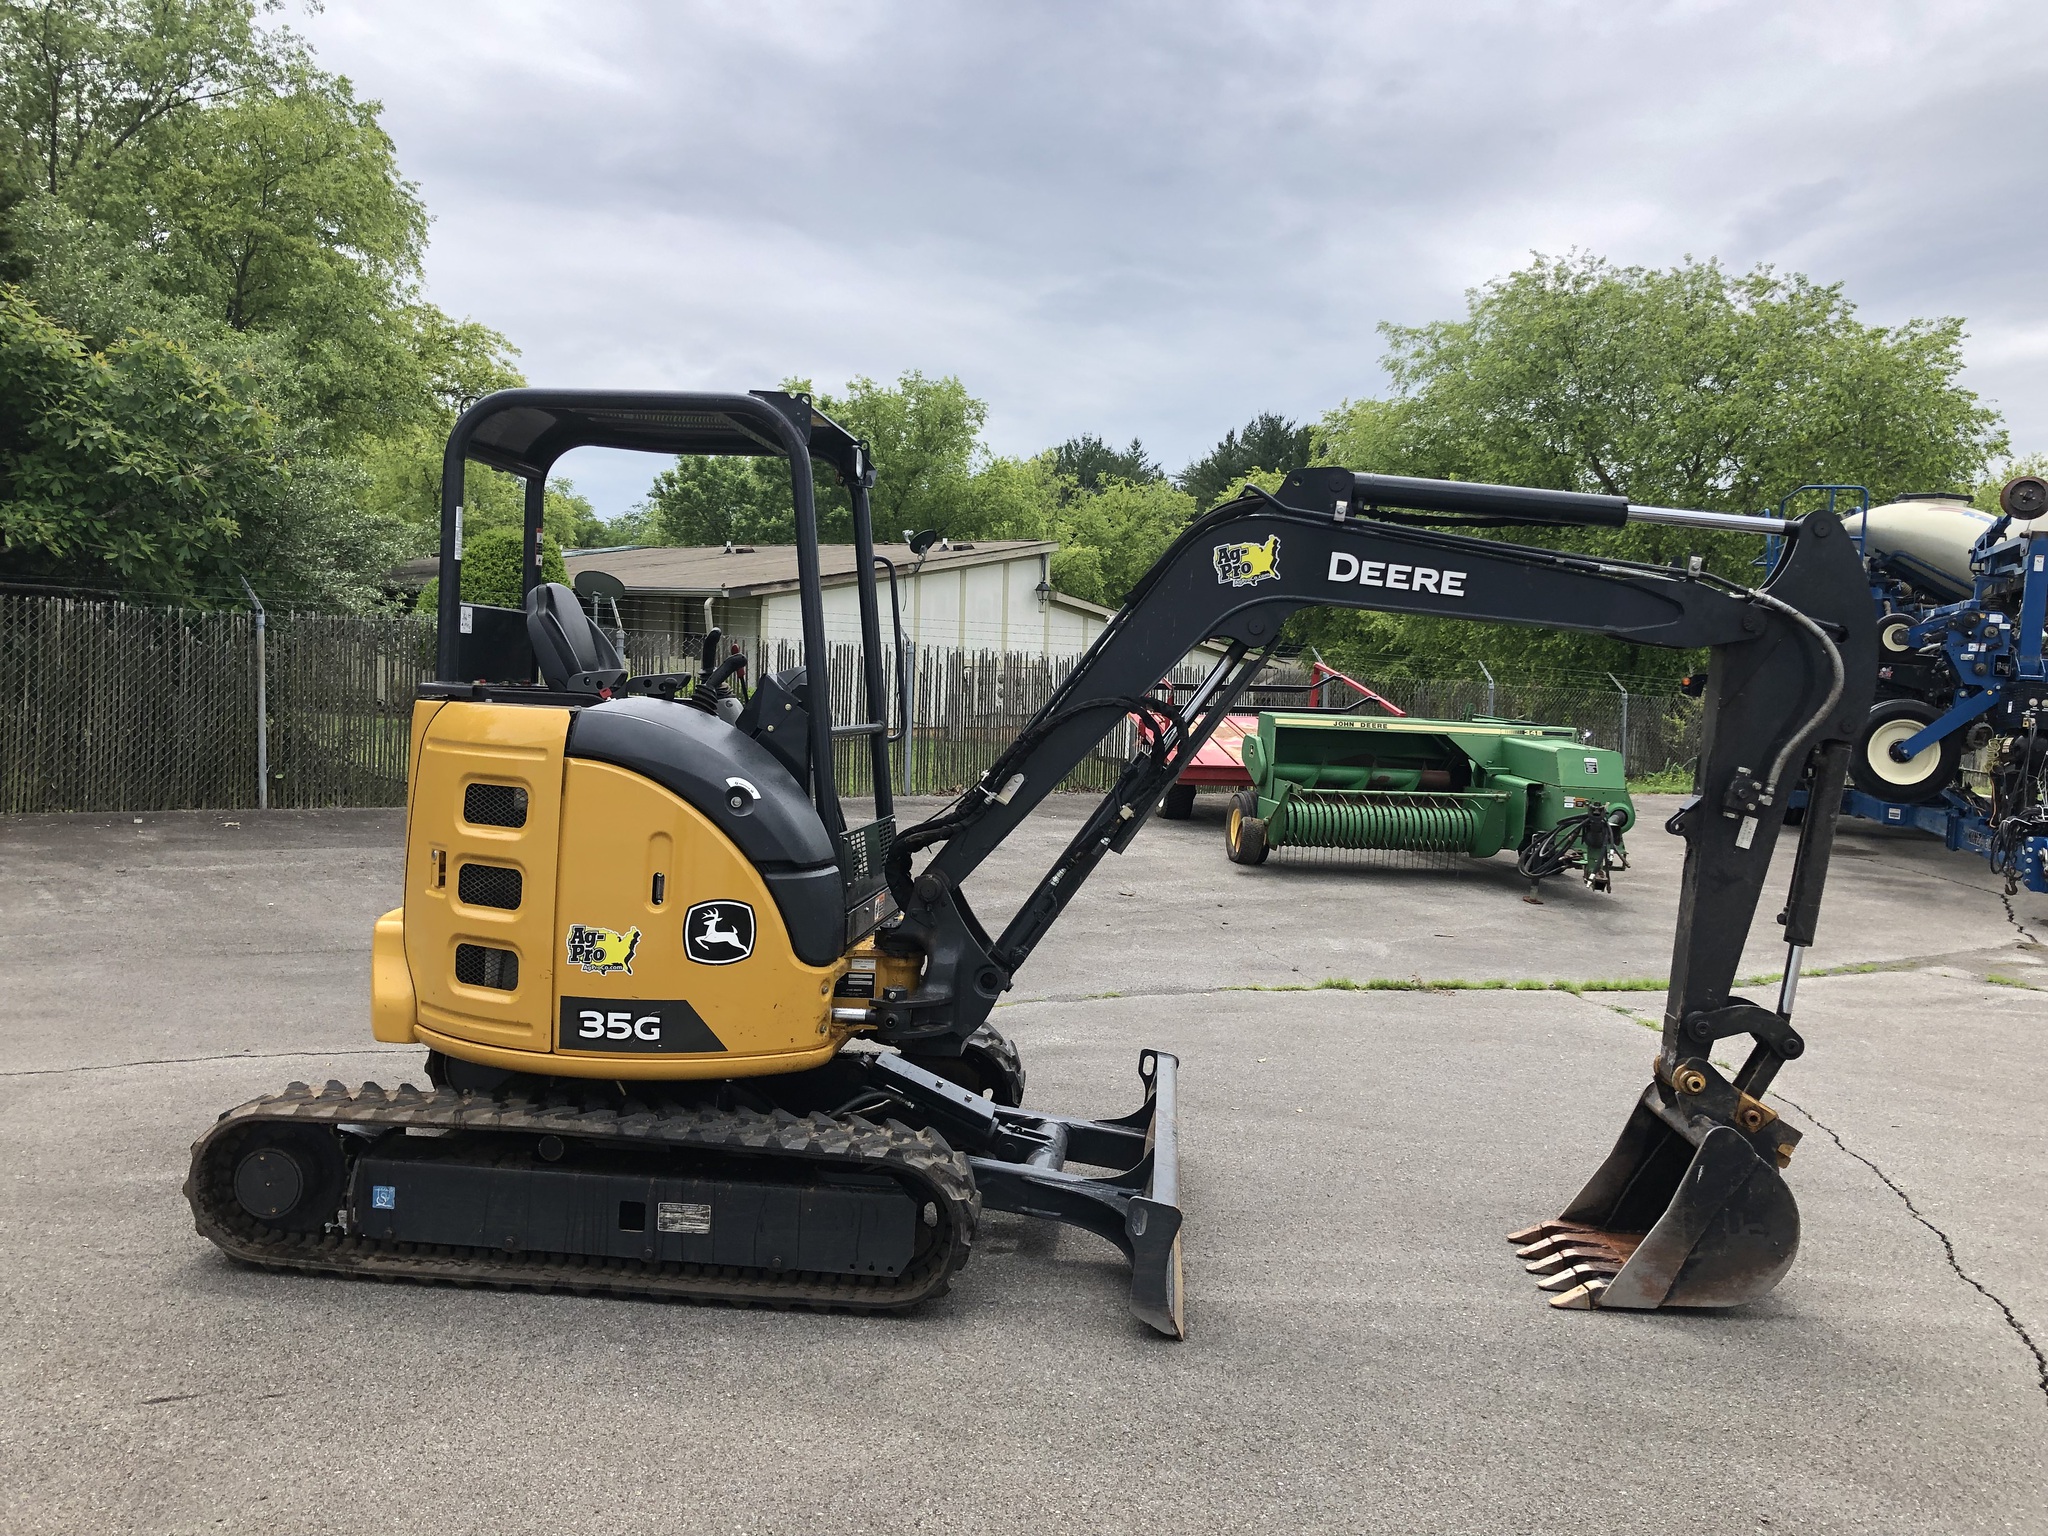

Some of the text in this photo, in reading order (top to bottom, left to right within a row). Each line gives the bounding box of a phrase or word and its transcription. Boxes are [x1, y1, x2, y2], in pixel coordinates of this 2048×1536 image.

[1218, 547, 1248, 565] Ag-
[1220, 563, 1252, 581] Pro
[1327, 551, 1467, 597] DEERE
[1360, 722, 1388, 730] DEERE
[569, 927, 605, 948] Ag-
[569, 945, 605, 963] Pro
[579, 1010, 660, 1041] 35G
